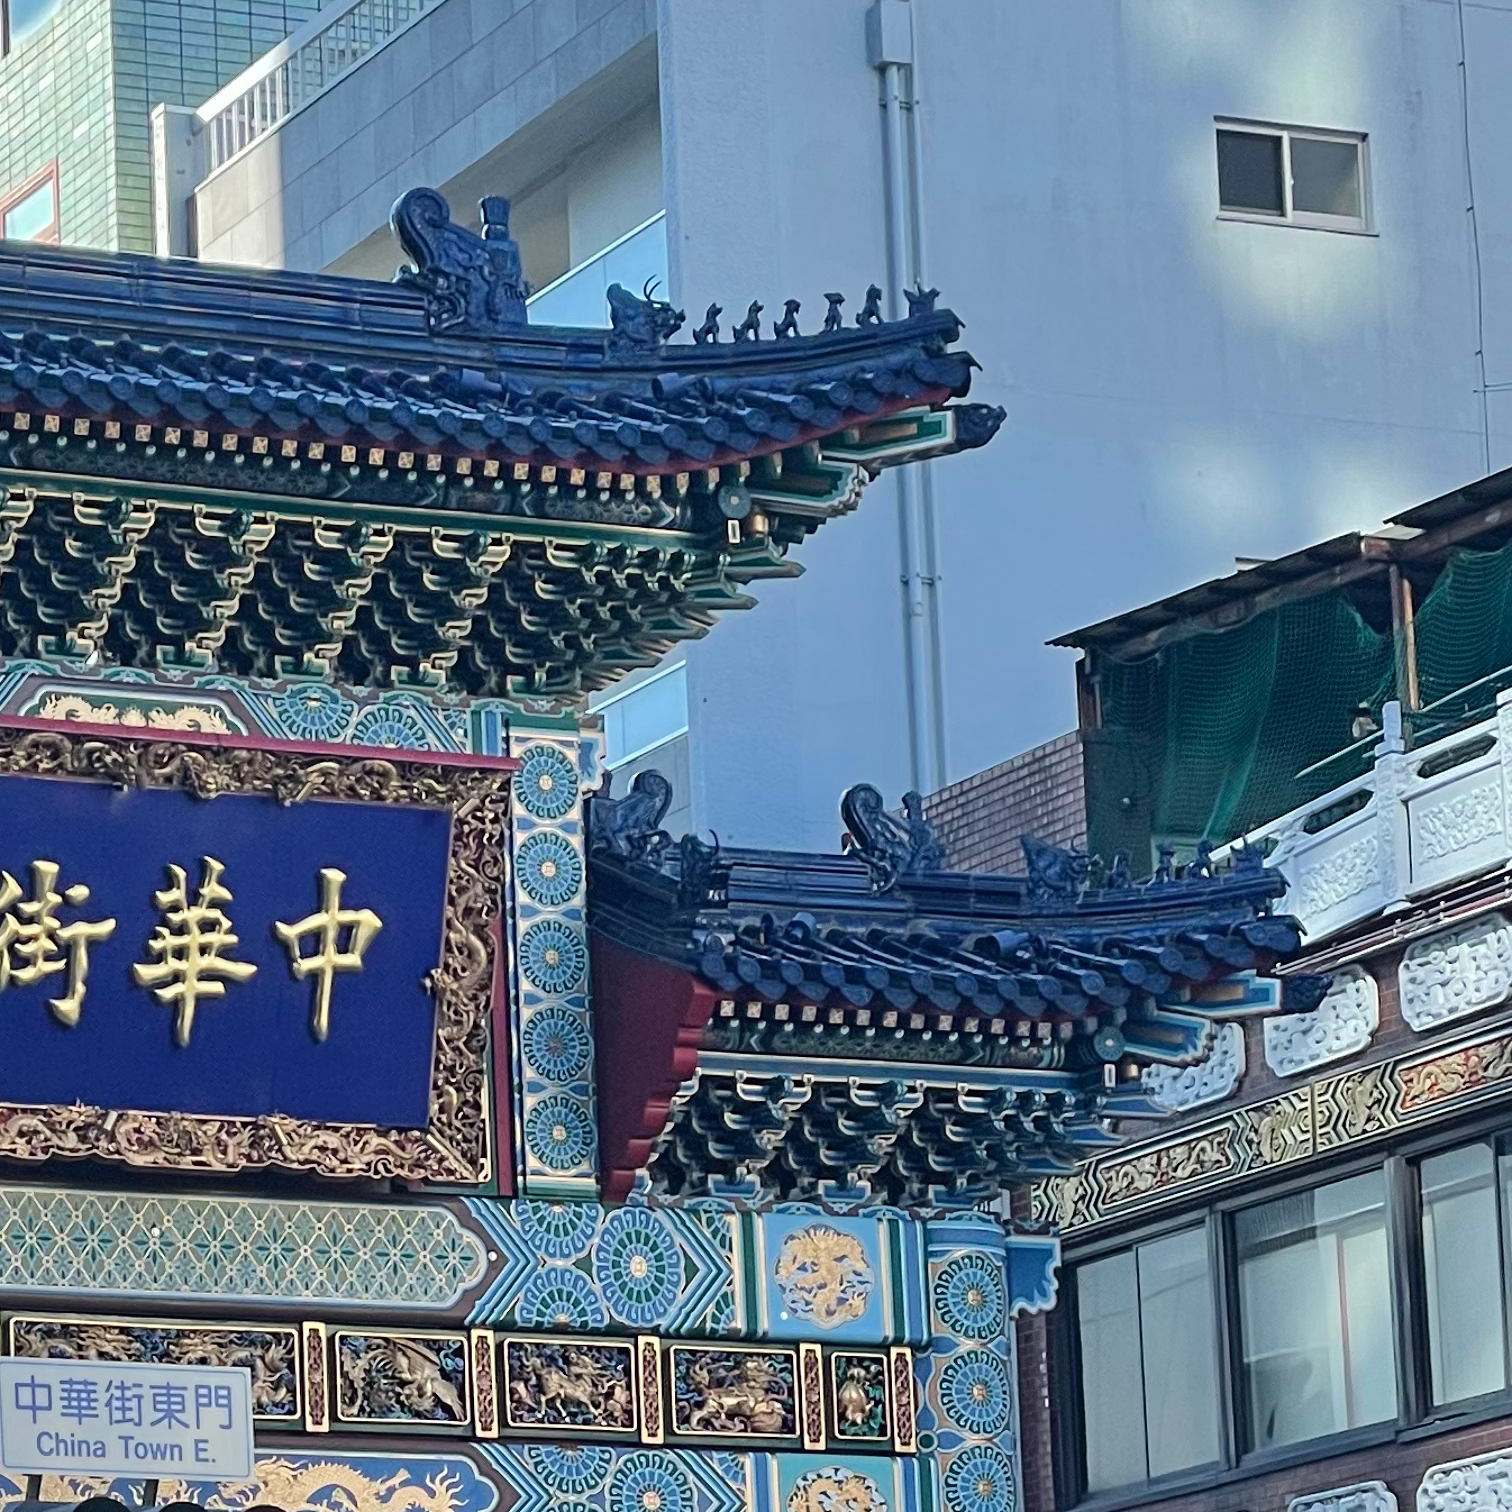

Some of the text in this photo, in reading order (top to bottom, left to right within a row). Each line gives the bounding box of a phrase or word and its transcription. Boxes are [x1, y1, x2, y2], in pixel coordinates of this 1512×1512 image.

[14, 1375, 234, 1431] 中華街東門
[36, 1431, 217, 1464] China Town E.
